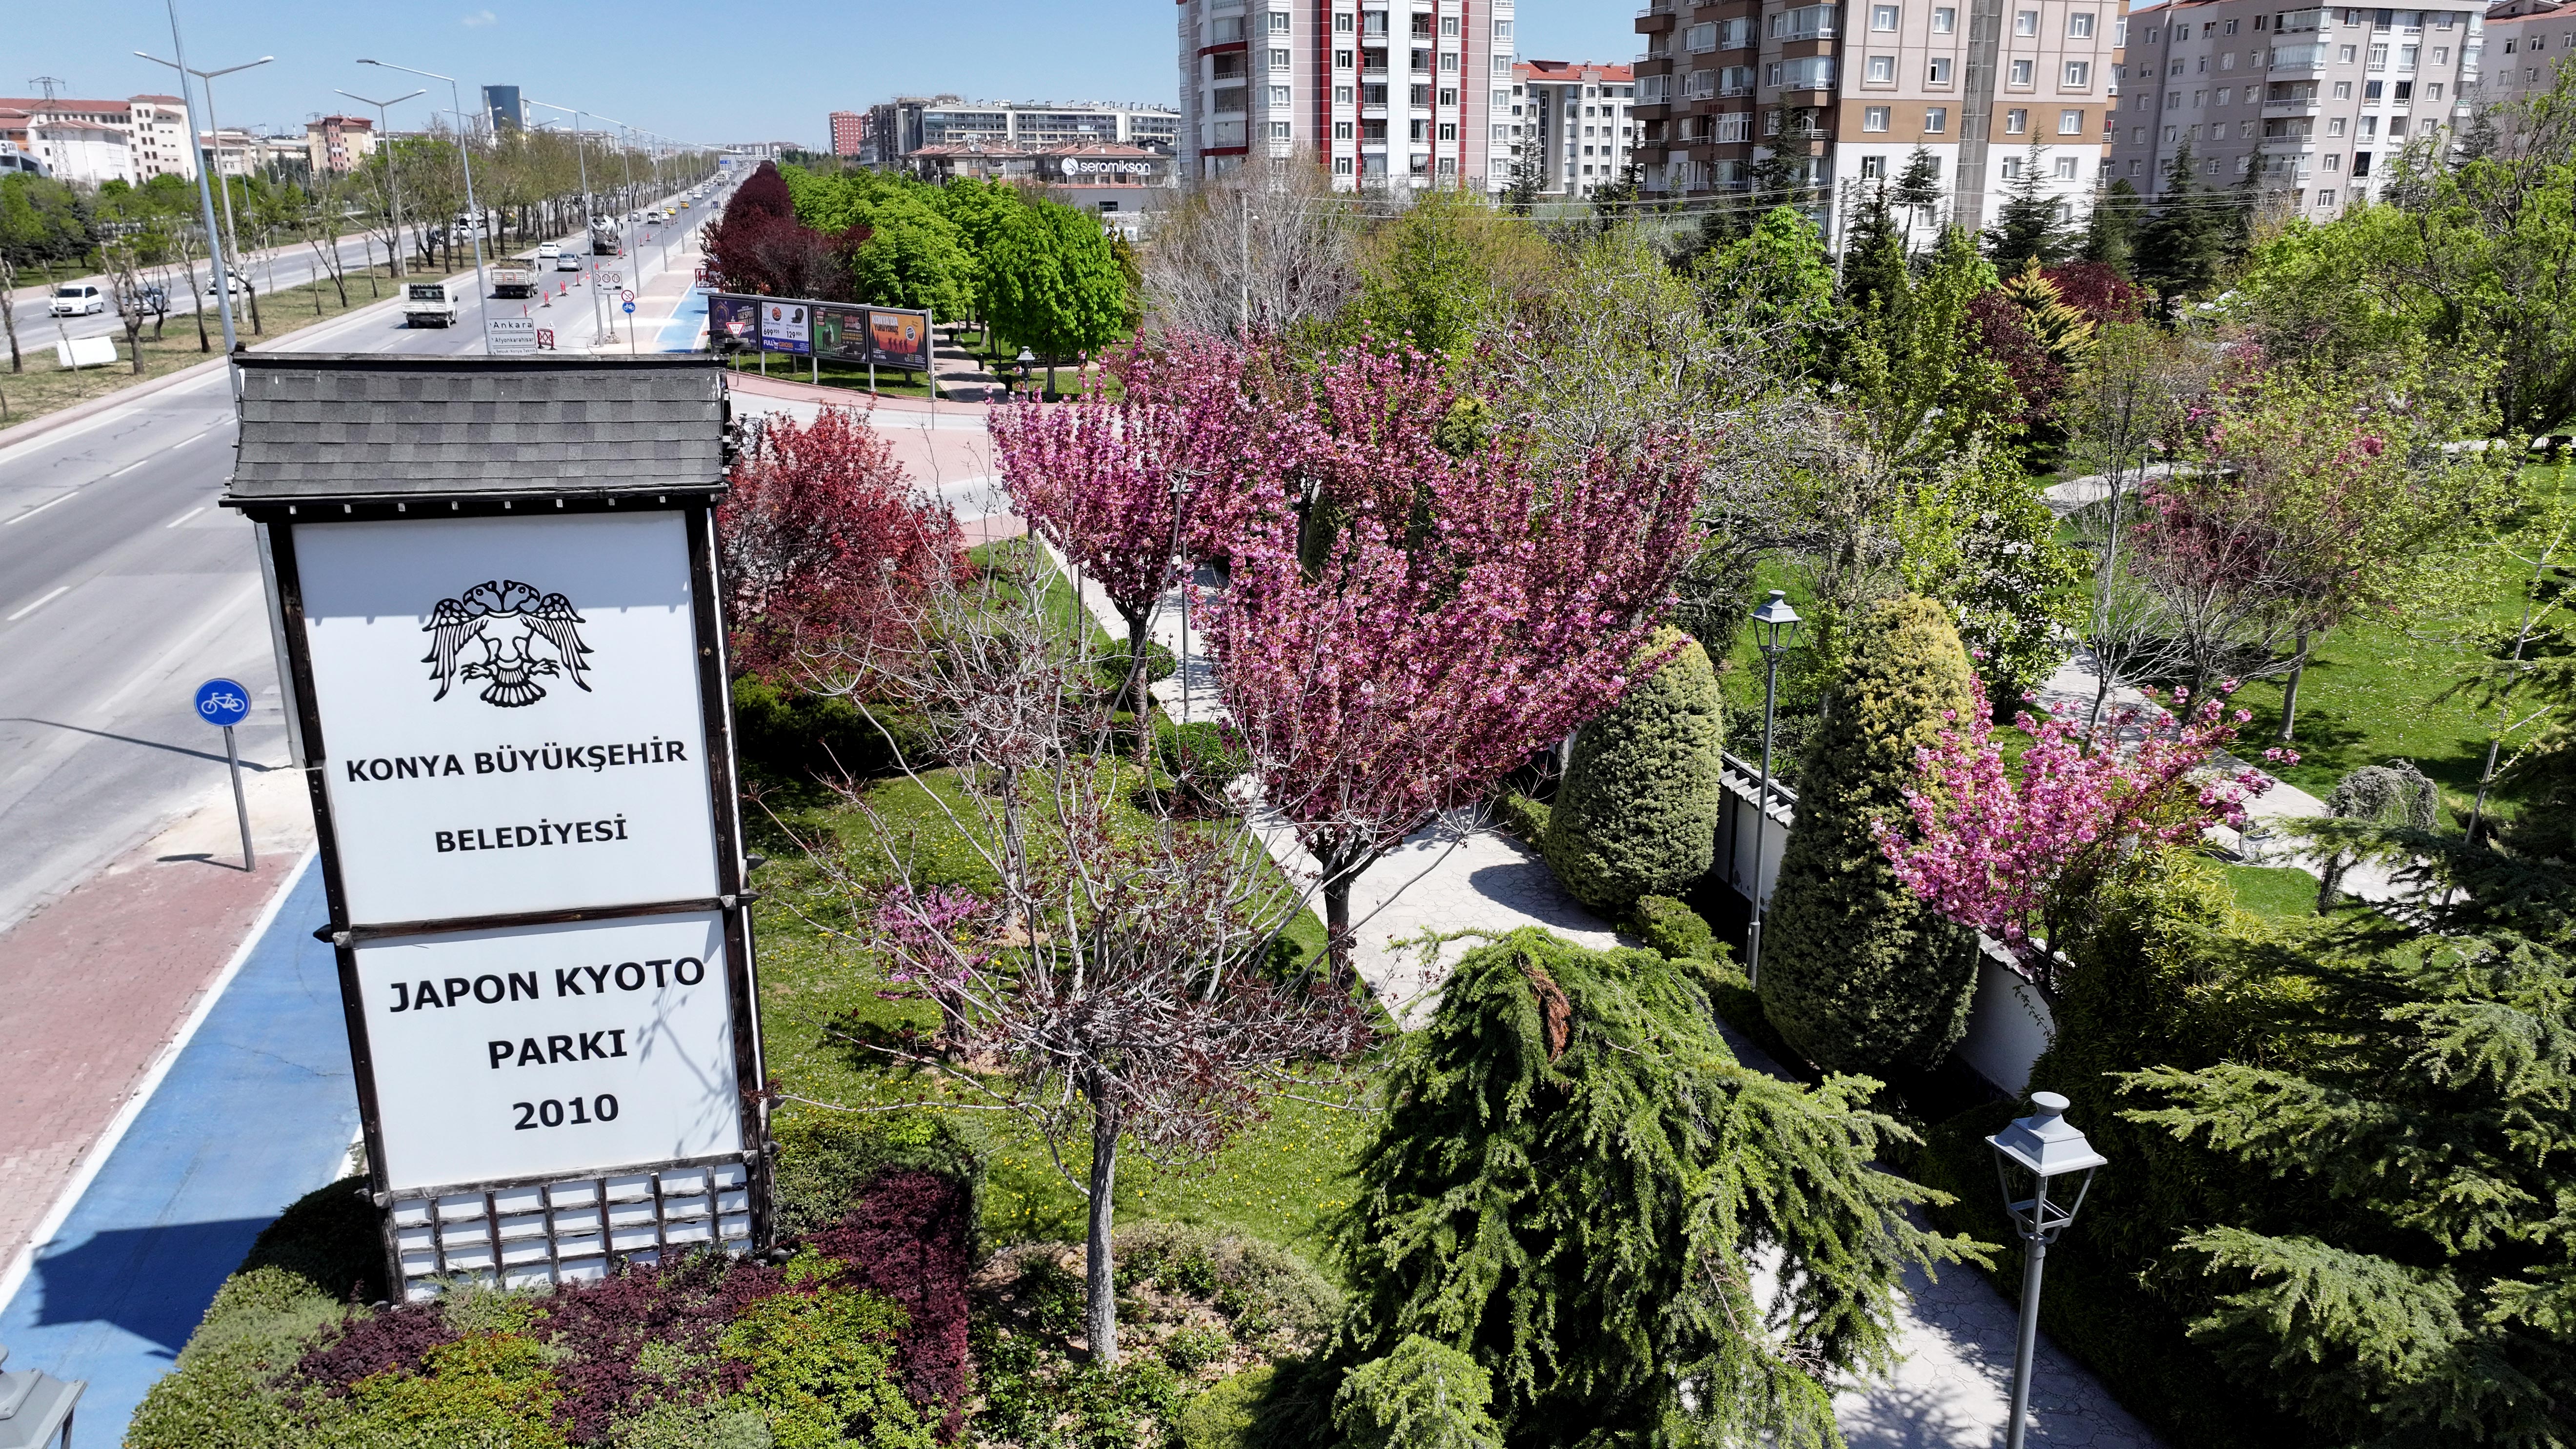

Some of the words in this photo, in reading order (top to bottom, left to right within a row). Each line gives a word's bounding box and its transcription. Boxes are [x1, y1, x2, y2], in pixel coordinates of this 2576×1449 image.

[1080, 160, 1150, 172] seramiksan
[872, 315, 898, 325] KONYA'DA
[347, 755, 465, 782] KONYA
[474, 736, 688, 774] BÜYÜKŞEHİR
[436, 813, 628, 853] BELEDİYESİ
[390, 971, 539, 1012] JAPON
[556, 957, 704, 997] KYOTO
[488, 1029, 627, 1069] PARKI
[513, 1094, 619, 1130] 2010
